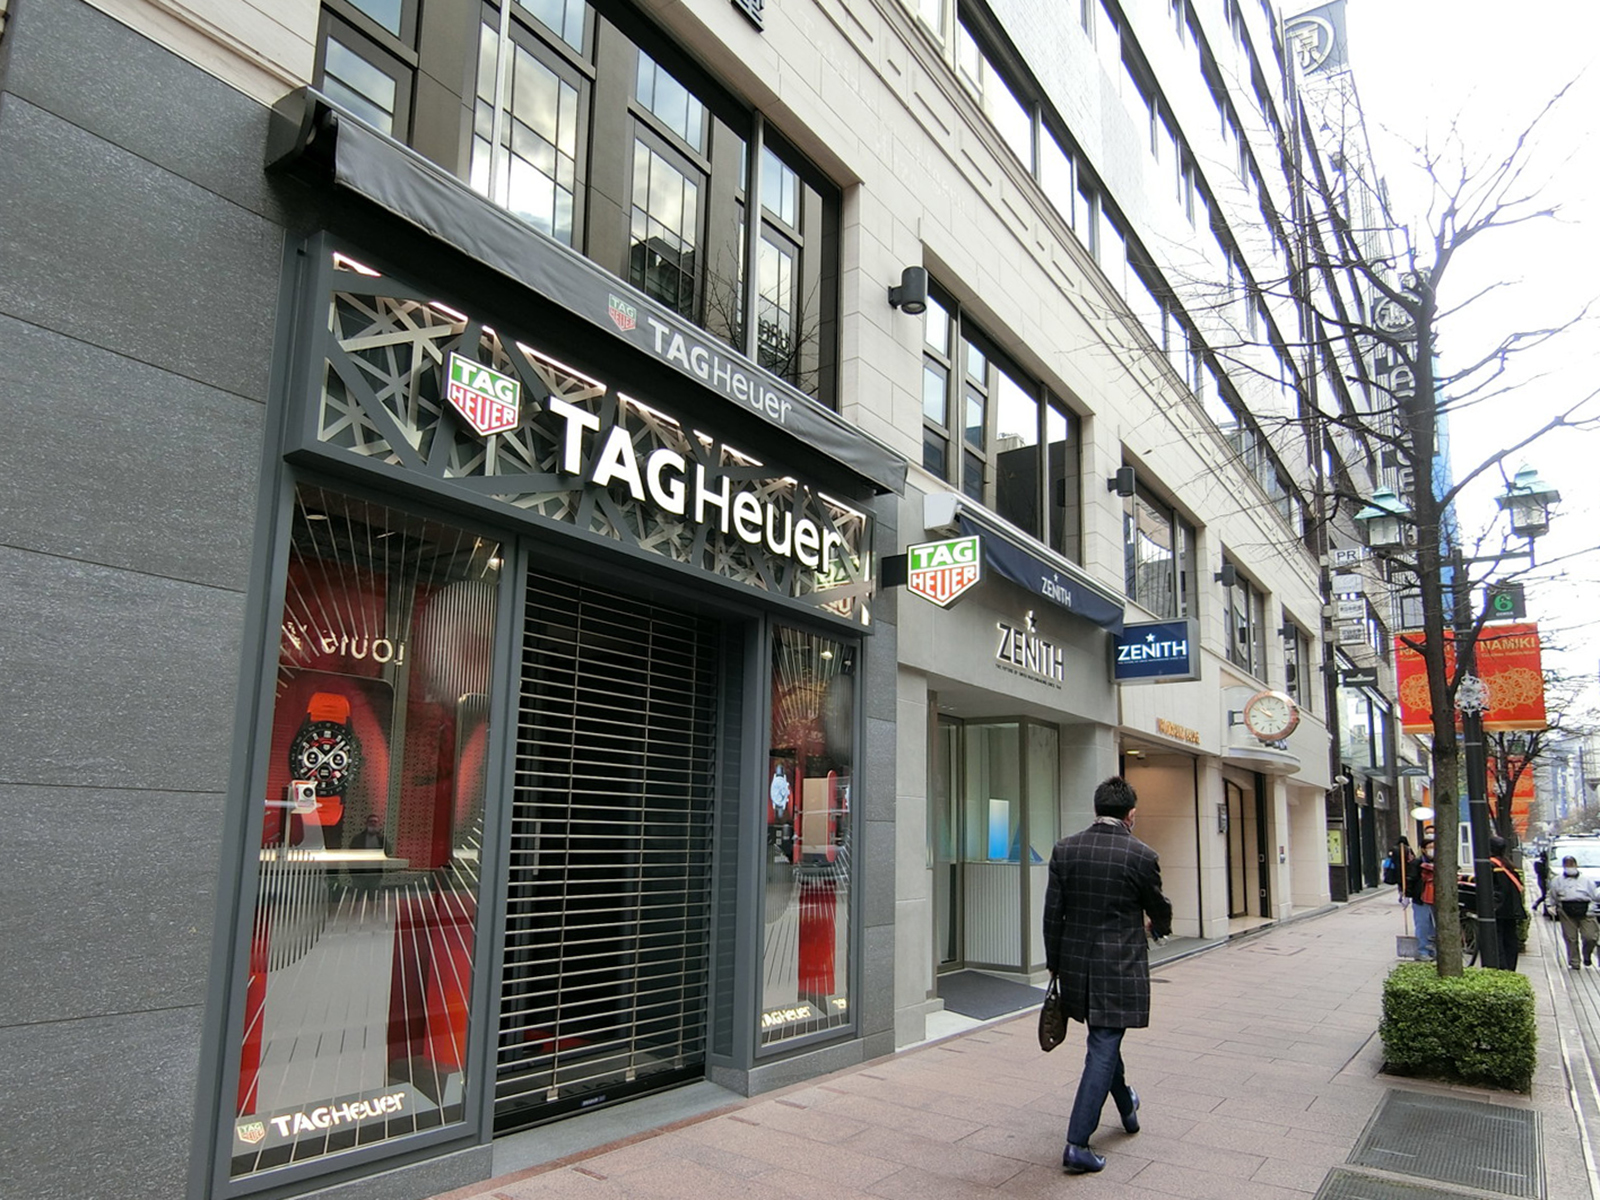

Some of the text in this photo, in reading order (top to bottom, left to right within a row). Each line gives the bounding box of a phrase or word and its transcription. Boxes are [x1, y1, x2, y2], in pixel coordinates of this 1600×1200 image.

[611, 297, 634, 318] TAG
[455, 359, 514, 404] TAG
[451, 385, 515, 431] HEUER
[913, 541, 973, 568] TAG
[1336, 550, 1357, 560] PR
[911, 566, 976, 600] HEUER
[1041, 576, 1072, 607] ZENITH
[1494, 593, 1514, 611] 6
[996, 622, 1064, 682] ZENITH
[1117, 640, 1187, 661] ZENITH
[1479, 637, 1536, 652] NAMIKI
